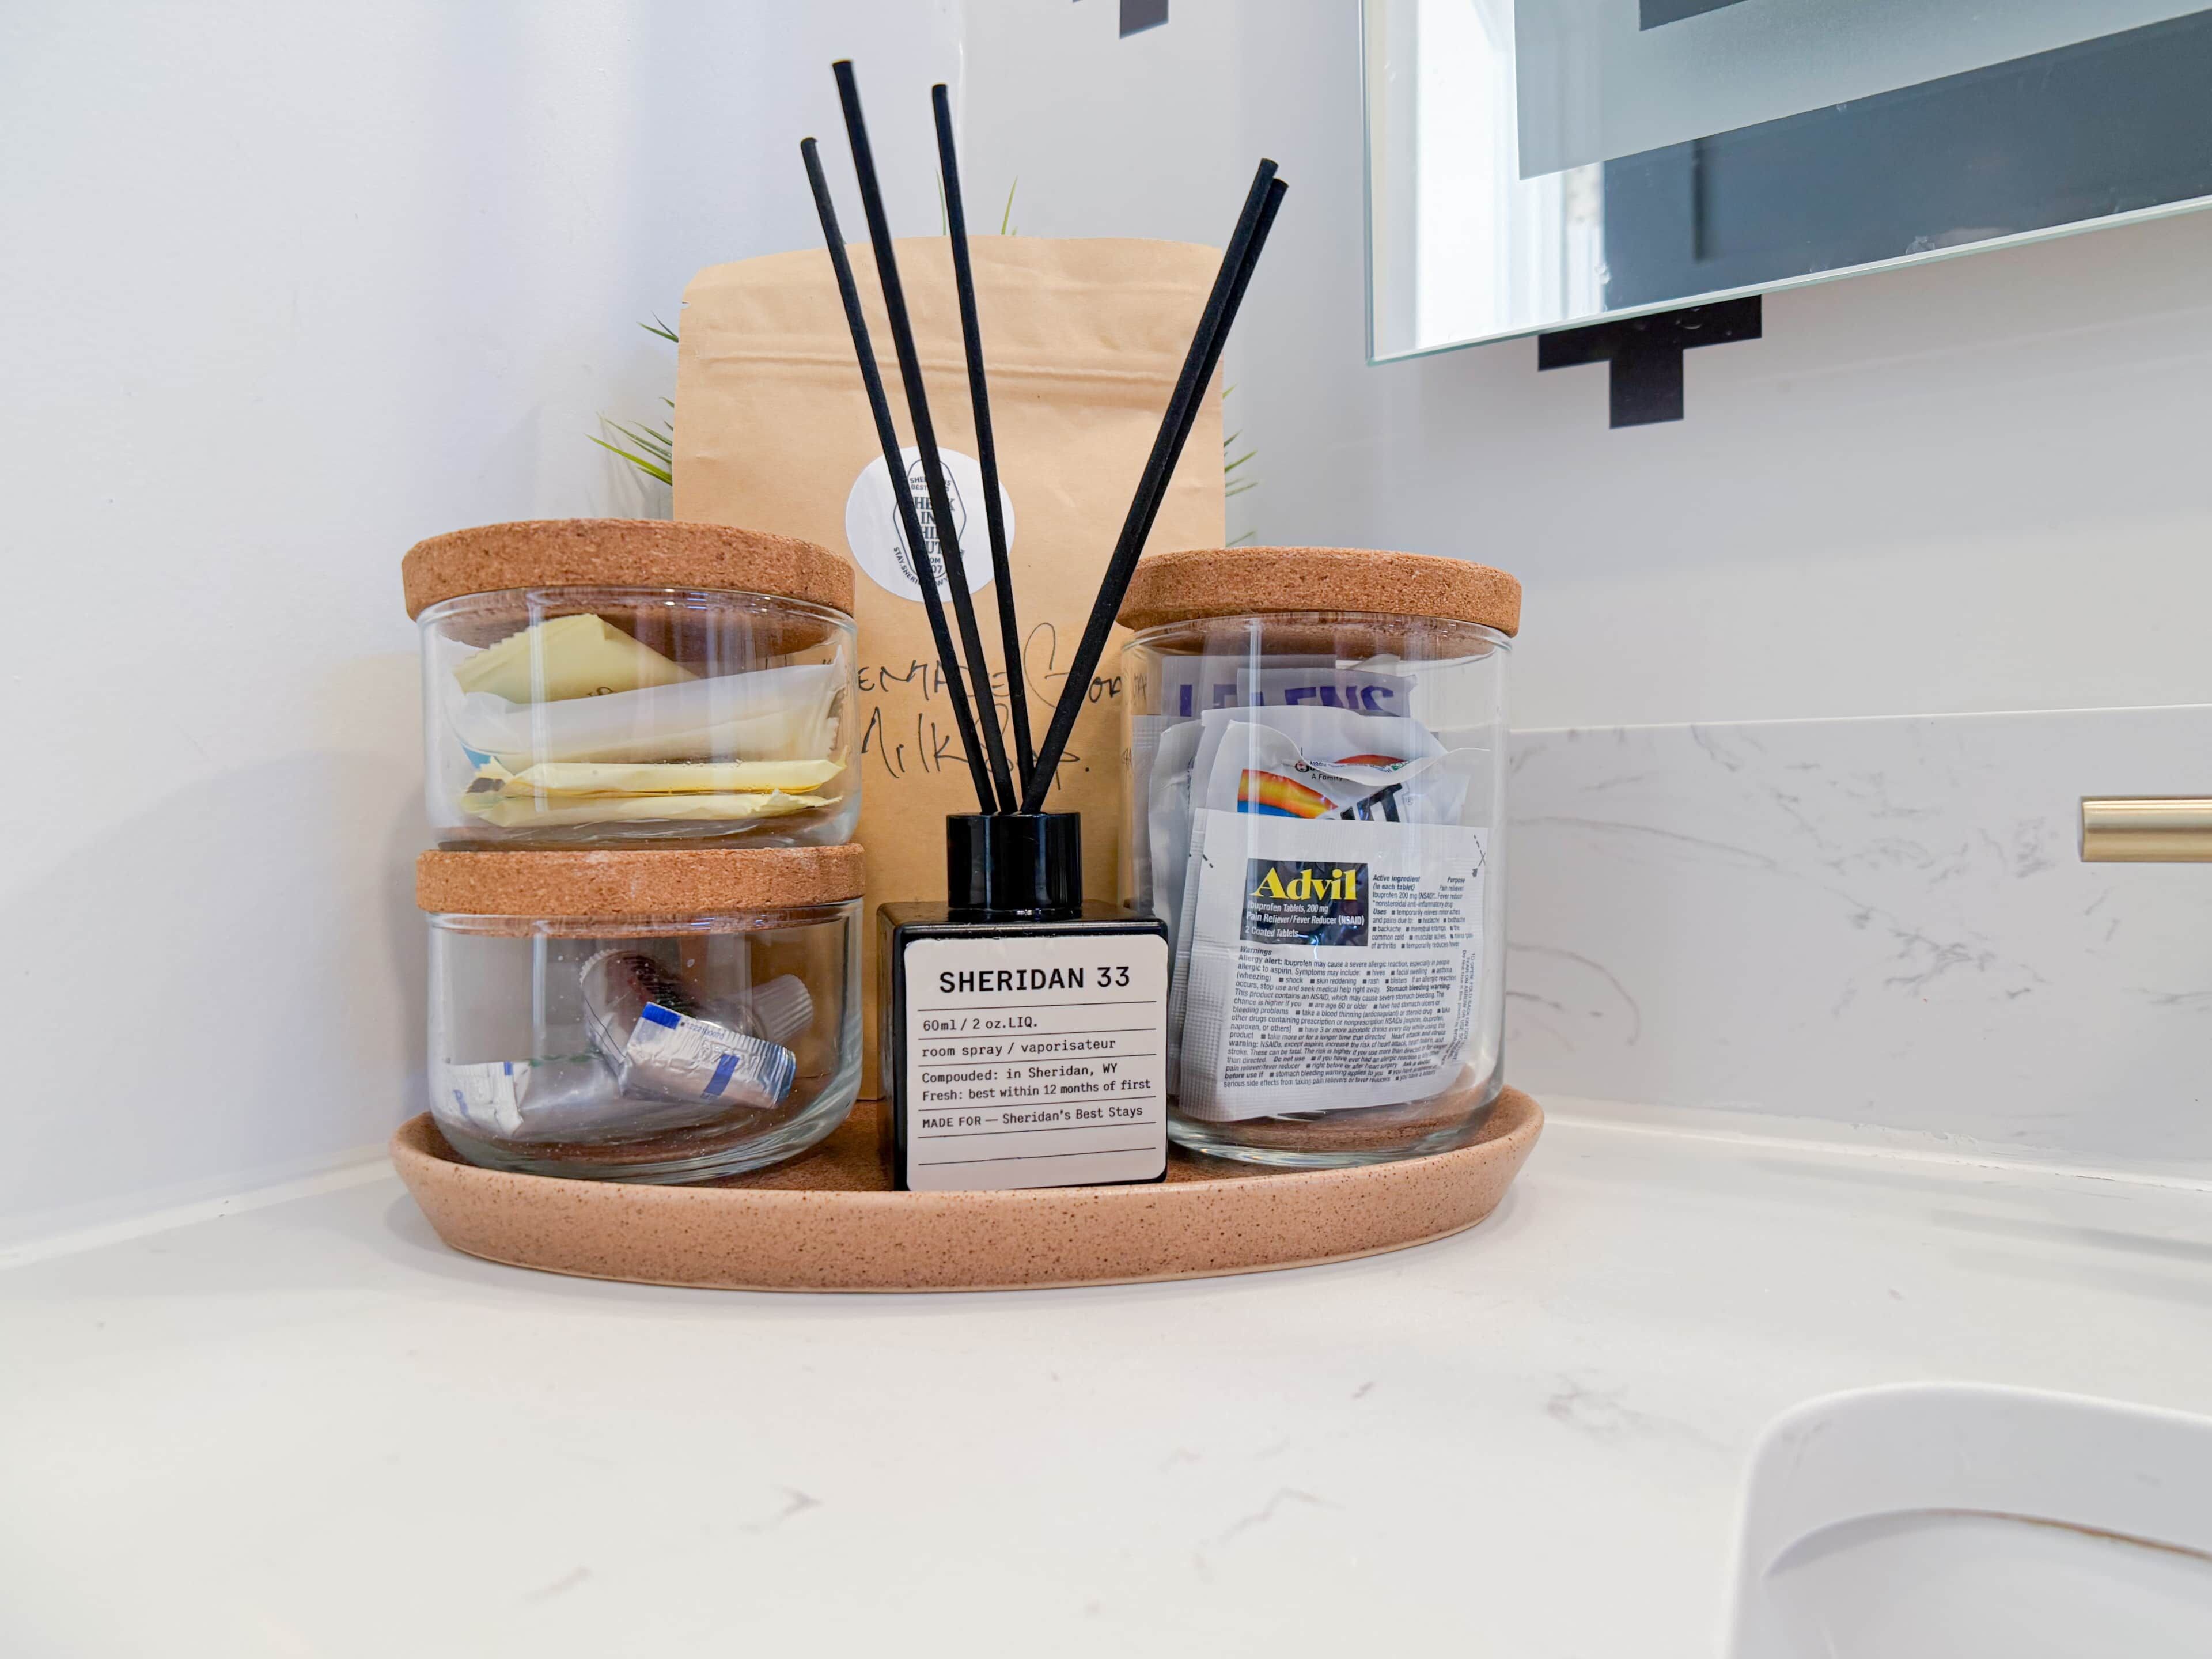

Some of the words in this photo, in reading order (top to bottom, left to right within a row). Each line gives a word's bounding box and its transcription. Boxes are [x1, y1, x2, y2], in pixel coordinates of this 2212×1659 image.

[1249, 867, 1357, 900] Advil
[1247, 900, 1282, 912] Ibuprofen
[1283, 904, 1305, 914] Tablets,
[1306, 904, 1318, 912] 200
[1319, 906, 1328, 914] mg
[1246, 912, 1262, 921] Pain
[1264, 914, 1310, 925] Reliever/Fever
[1312, 915, 1336, 925] Reducer
[1251, 927, 1275, 937] Coated
[1277, 929, 1299, 937] Tablets
[1240, 946, 1272, 955] Warnings
[1239, 955, 1263, 964] Allergy
[1284, 959, 1312, 967] Ibuprofen
[1238, 963, 1261, 972] allergic
[1296, 968, 1325, 976] Symptoms
[939, 967, 1085, 993] SHERIDAN
[1097, 966, 1130, 987] 33
[1260, 983, 1274, 991] stop
[1340, 986, 1351, 994] help
[1265, 999, 1283, 1007] higher
[1233, 1006, 1259, 1014] bleeding
[923, 1019, 956, 1032] 60ml
[973, 1018, 980, 1029] 2
[1301, 1017, 1336, 1025] prescription
[922, 1047, 955, 1058] room
[962, 1043, 1003, 1058] spray
[1021, 1039, 1116, 1056] vaporisateur
[922, 1070, 999, 1084] Compouded:
[1006, 1068, 1021, 1079] in
[1028, 1066, 1094, 1078] Sheridan,
[1103, 1063, 1118, 1074] WY
[923, 1090, 963, 1101] Fresh:
[968, 1088, 995, 1099] best
[999, 1086, 1039, 1097] within
[1044, 1085, 1056, 1095] 12
[1060, 1081, 1099, 1094] months
[1104, 1080, 1116, 1092] of
[1120, 1078, 1151, 1090] first
[922, 1118, 953, 1128] MADE
[959, 1116, 981, 1127] FOR
[1076, 1108, 1104, 1120] Best
[1109, 1106, 1143, 1119] Stays
